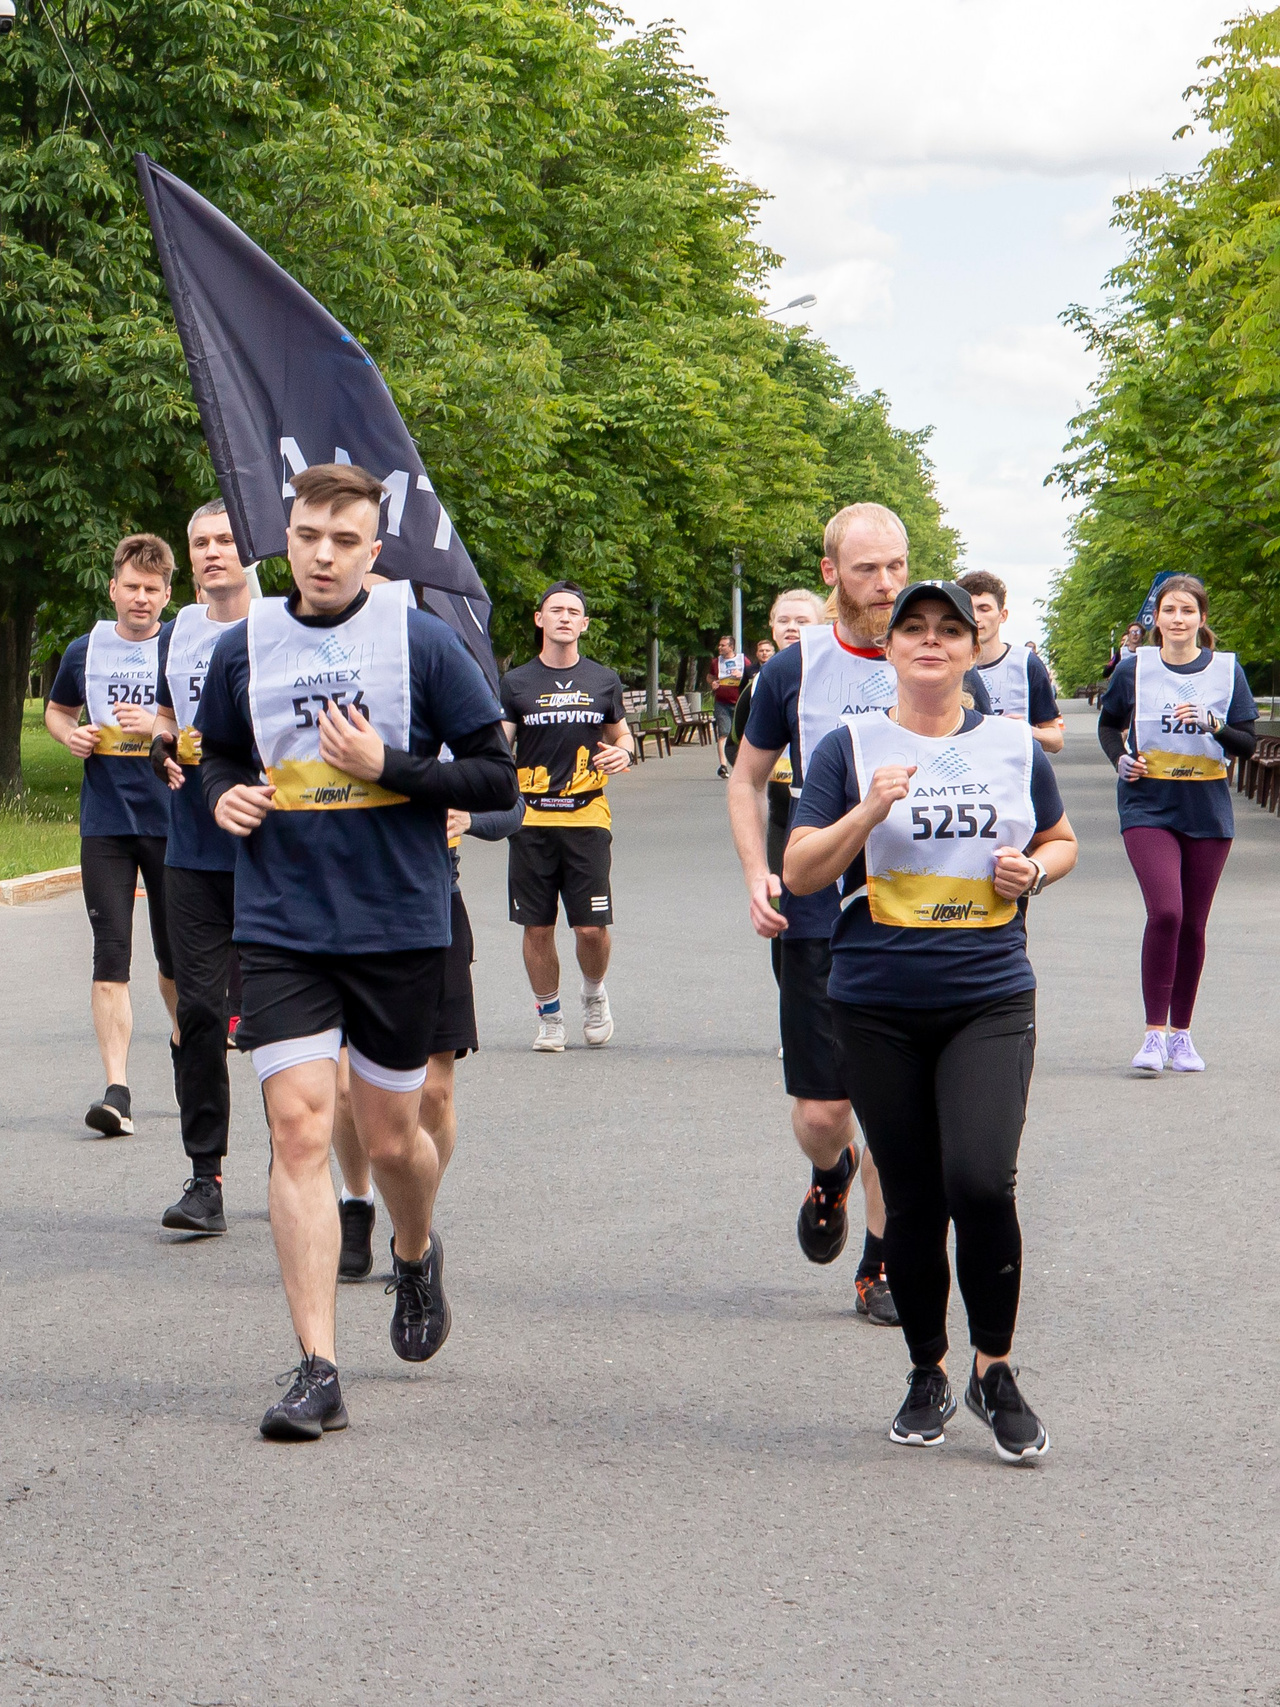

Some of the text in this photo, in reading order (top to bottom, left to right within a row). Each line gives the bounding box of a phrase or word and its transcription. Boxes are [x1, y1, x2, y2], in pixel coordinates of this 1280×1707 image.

[110, 671, 153, 679] AMTEX
[293, 669, 362, 688] AMTEX
[107, 684, 156, 706] 5265
[314, 782, 352, 805] URBAN
[913, 783, 991, 798] AMTEX
[910, 803, 998, 841] 5252
[931, 899, 974, 923] URBAN
